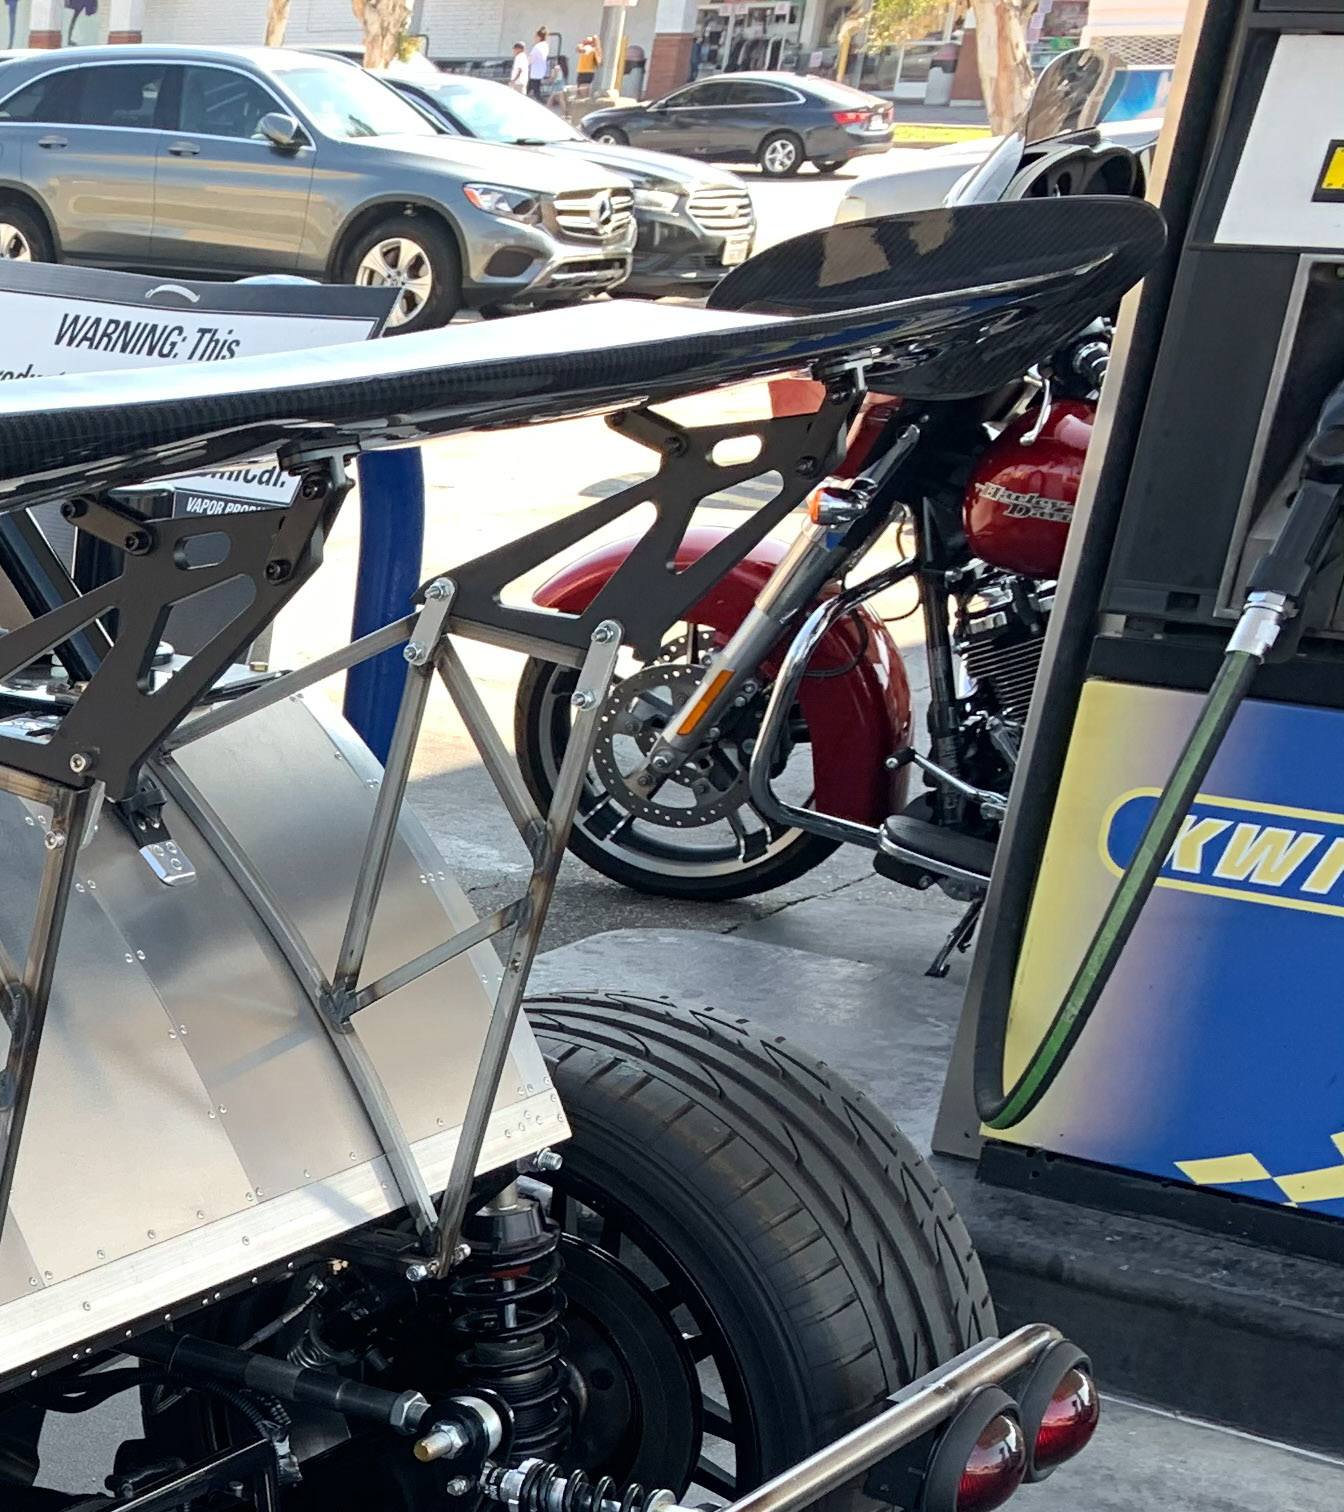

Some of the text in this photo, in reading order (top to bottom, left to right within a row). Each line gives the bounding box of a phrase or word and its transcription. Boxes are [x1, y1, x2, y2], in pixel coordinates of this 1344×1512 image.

[54, 312, 241, 362] WARNING: This
[186, 496, 225, 515] VAPOR
